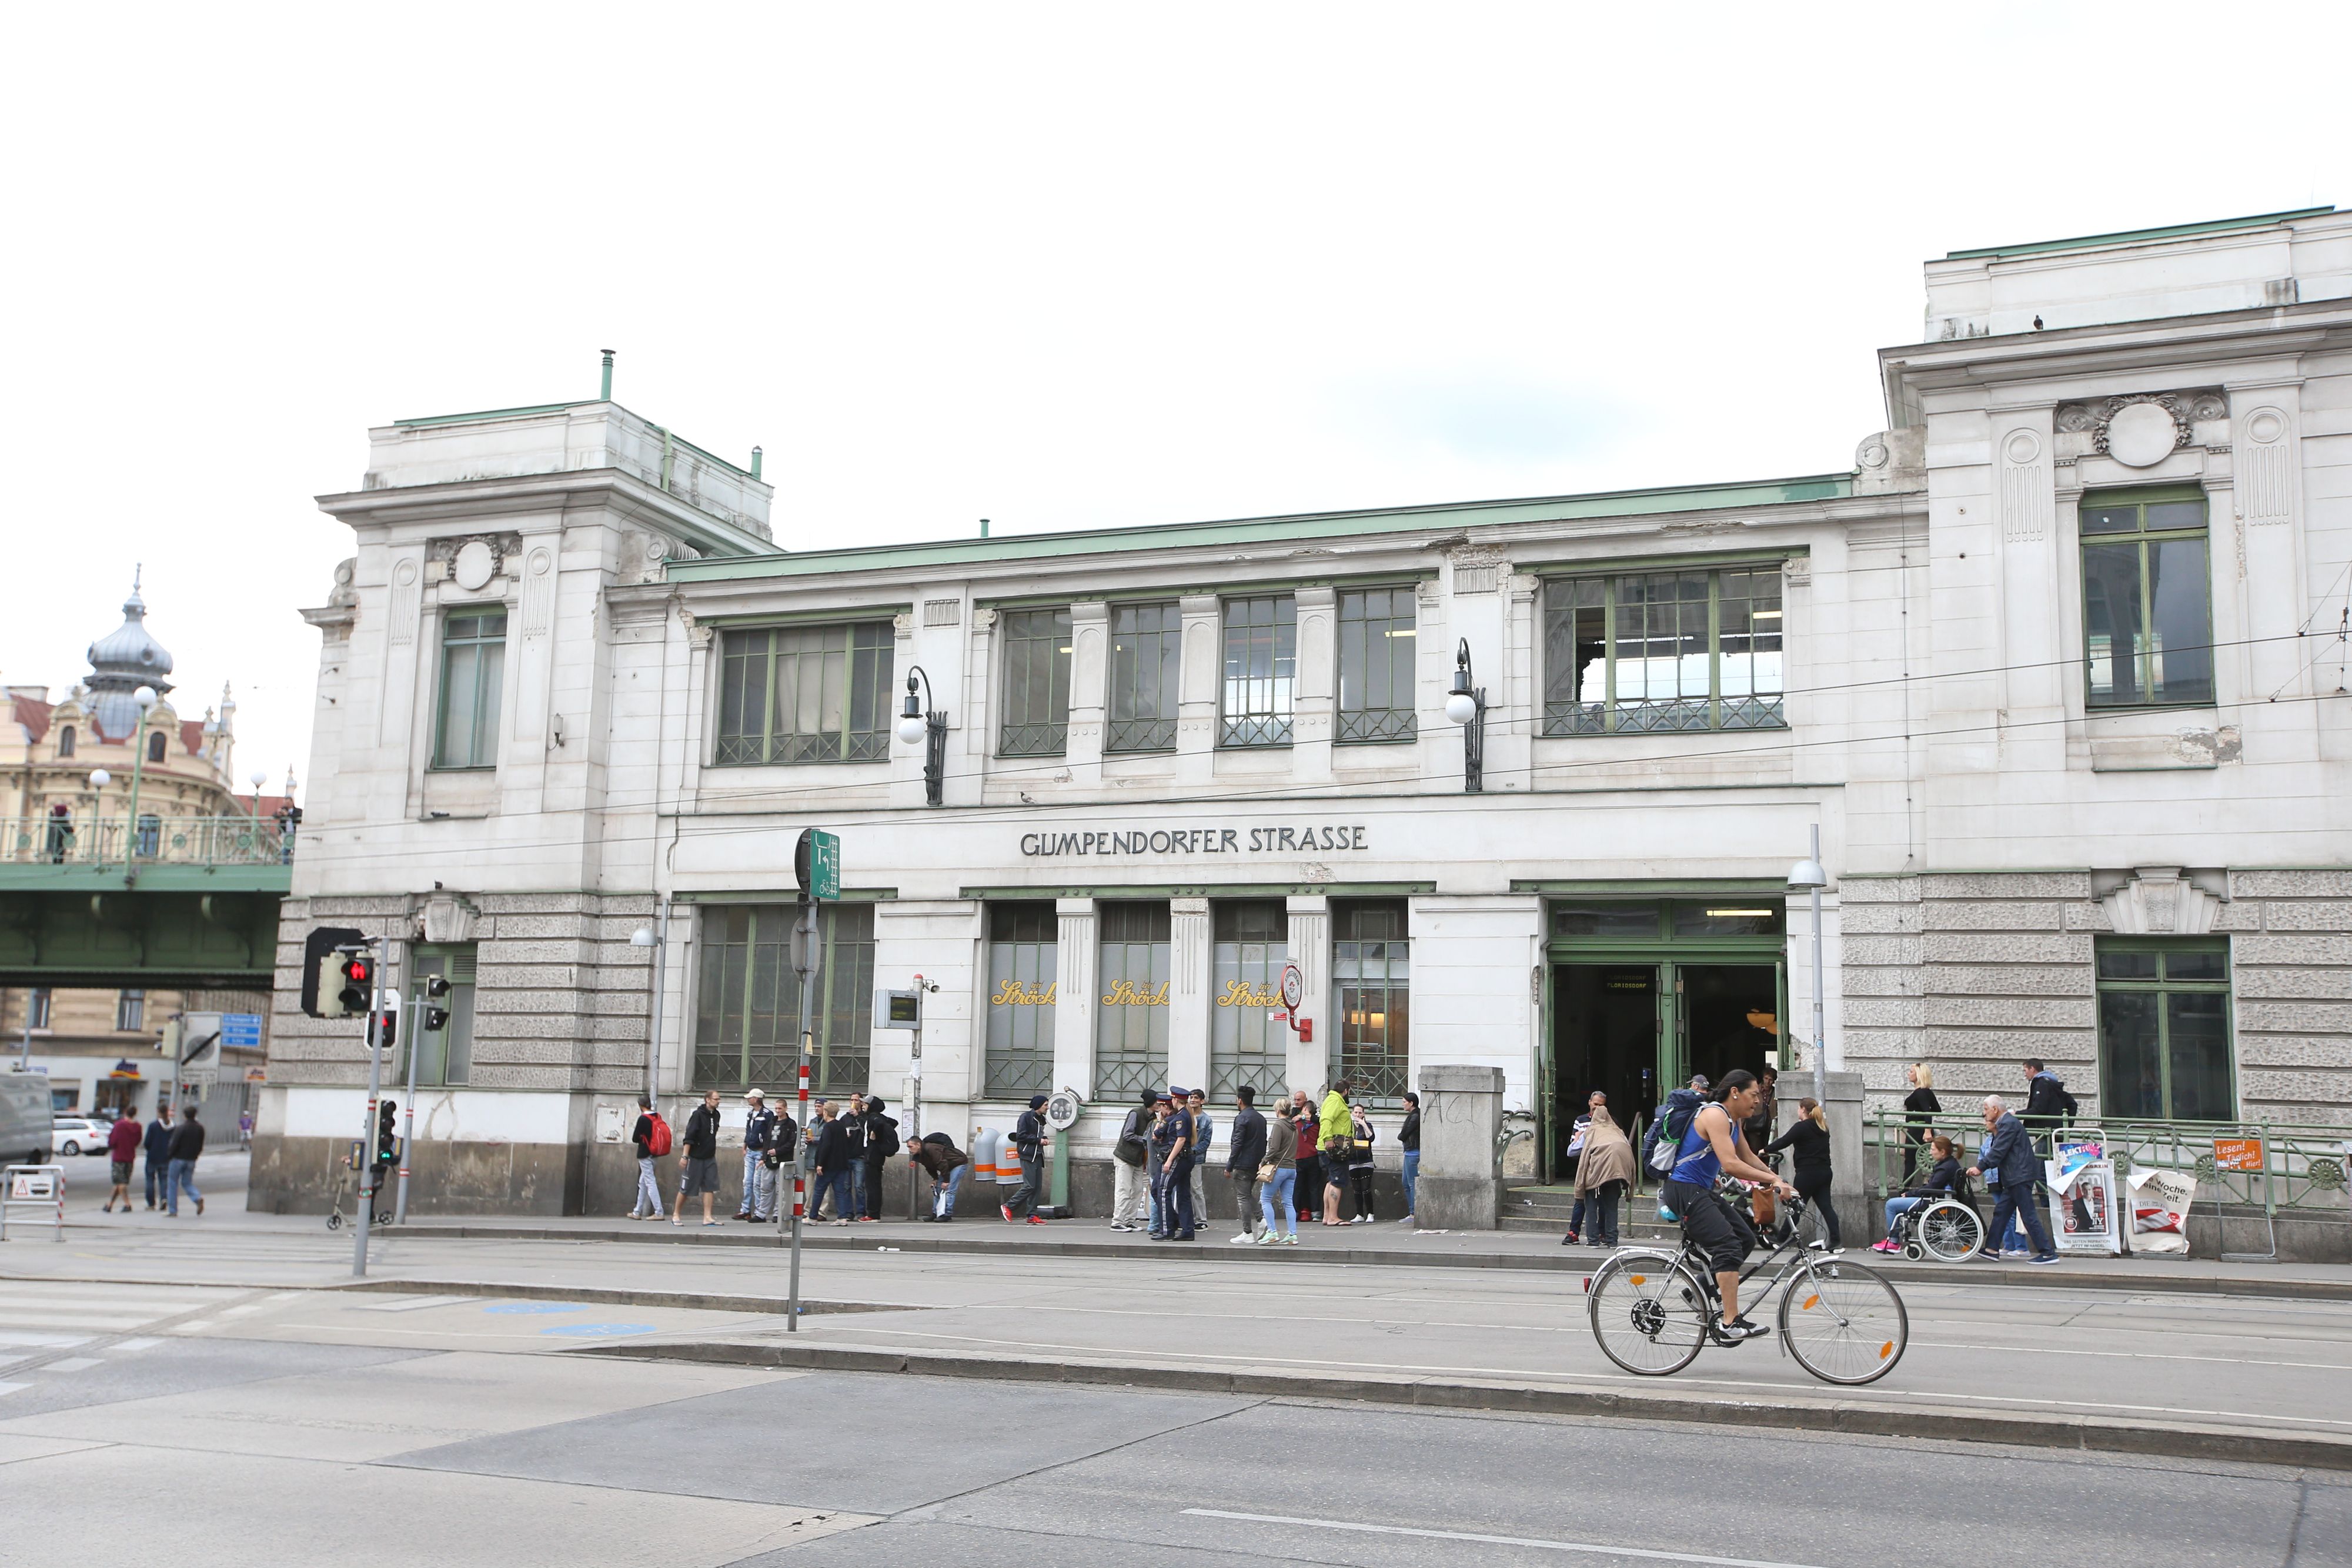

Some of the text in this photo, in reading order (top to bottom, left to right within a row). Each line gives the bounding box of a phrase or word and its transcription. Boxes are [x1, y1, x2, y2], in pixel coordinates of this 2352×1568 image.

[1020, 826, 1368, 856] GUMPENDORFER STRASSE
[991, 978, 1057, 1005] Ströck
[1101, 978, 1170, 1006] Ströck
[1216, 979, 1287, 1008] Ströck
[2217, 1141, 2245, 1154] Lesen!
[2246, 1159, 2260, 1168] Hier!
[2156, 1178, 2187, 1195] Woche.
